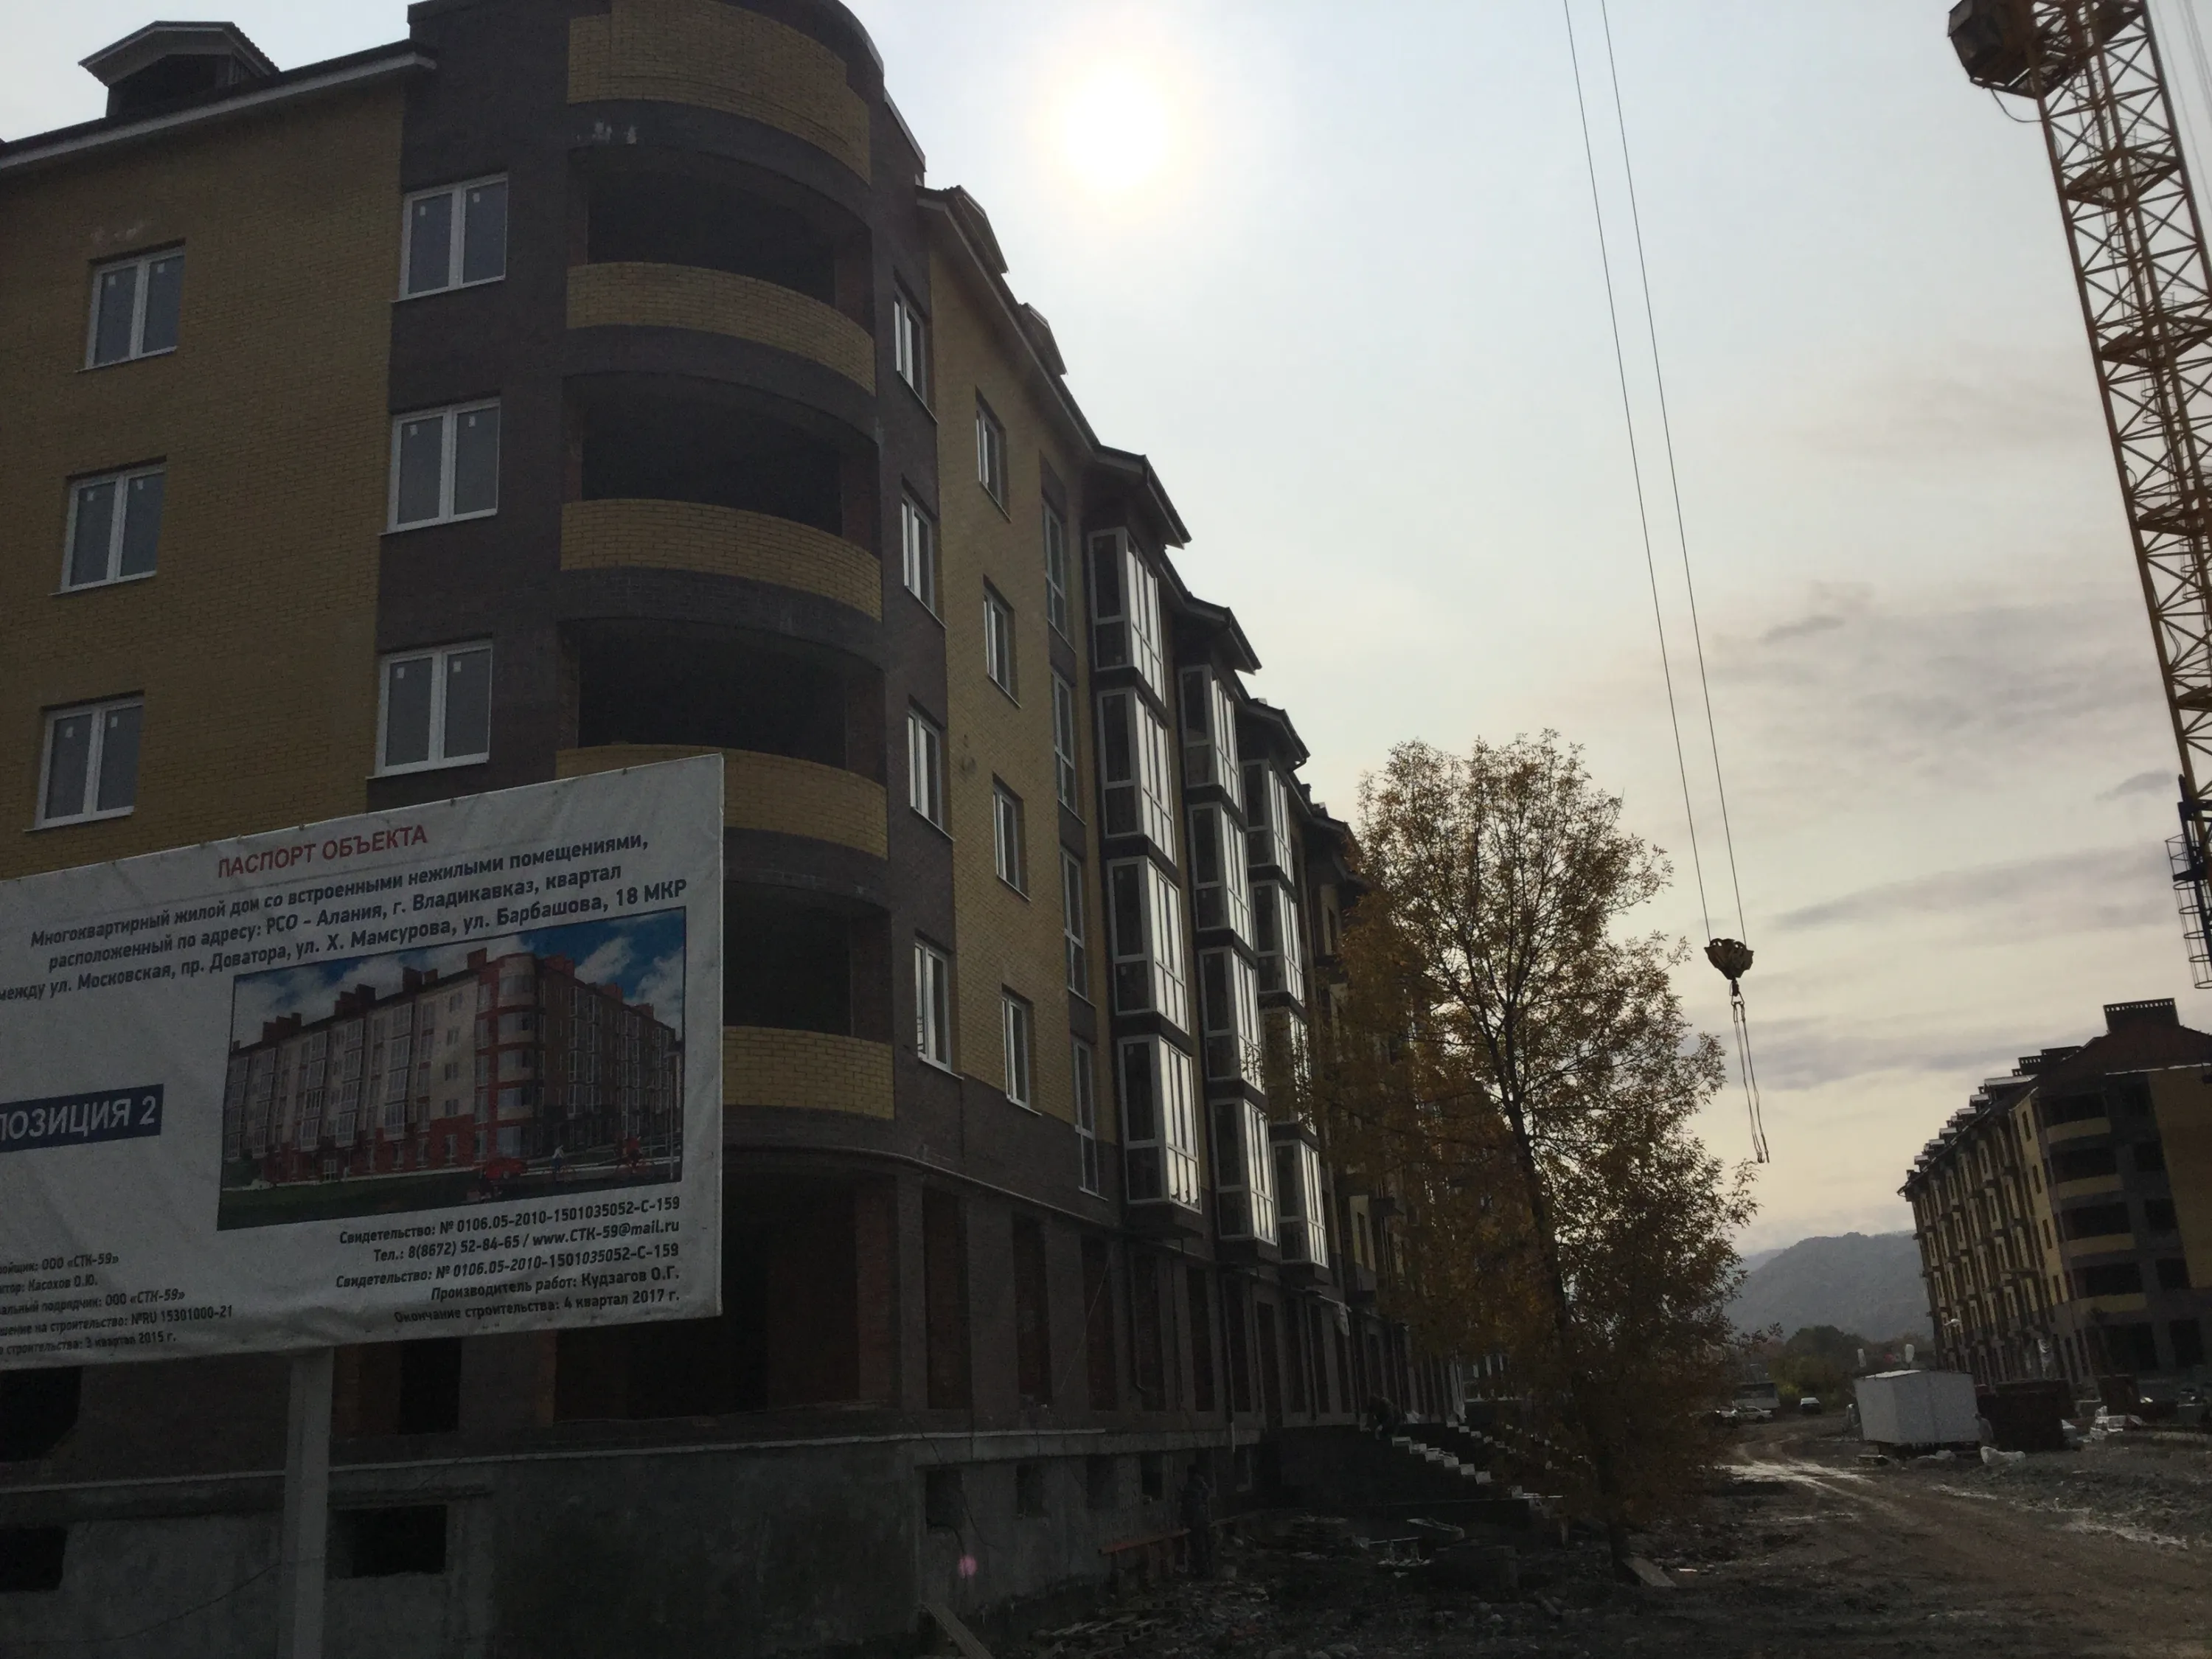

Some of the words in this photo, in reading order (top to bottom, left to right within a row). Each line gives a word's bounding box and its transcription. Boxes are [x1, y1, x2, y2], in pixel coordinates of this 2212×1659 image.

[218, 844, 316, 878] ПАСПОРТ
[322, 824, 427, 860] ОБЪЕКТА
[30, 909, 170, 947] Многоквартирный
[174, 900, 225, 923] жилой
[230, 897, 260, 917] дом
[264, 894, 282, 908] со
[288, 874, 403, 906] встроенными
[408, 858, 503, 884] нежилыми
[509, 836, 649, 870] помещениями,
[49, 935, 173, 973] расположенный
[177, 935, 196, 950] по
[201, 925, 261, 948] адресу:
[266, 914, 297, 934] РСО
[317, 902, 387, 926] Алания,
[392, 901, 406, 915] г.
[413, 879, 539, 911] Владикавказ,
[546, 866, 621, 891] квартал
[50, 981, 72, 998] ул.
[77, 965, 175, 990] Московская,
[181, 961, 204, 980] пр.
[209, 945, 291, 973] Доватора,
[296, 942, 319, 959] ул.
[351, 920, 457, 947] Мамсурова,
[464, 917, 490, 935] ул.
[497, 897, 608, 925] Барбашова,
[616, 886, 638, 907] 18
[644, 878, 686, 901] МКР
[139, 1096, 156, 1125] 2
[340, 1227, 435, 1244] Свидетельство:
[439, 1221, 453, 1234] №
[374, 1248, 404, 1262] Тел.:
[408, 1242, 456, 1261] 8(8672)
[461, 1237, 519, 1253] 52-84-65
[523, 1234, 529, 1248] /
[336, 1271, 432, 1288] Свидетельство:
[436, 1266, 450, 1279] №
[431, 1280, 532, 1302] Производитель
[536, 1276, 577, 1293] работ:
[582, 1271, 647, 1288] Кудзагов
[651, 1266, 679, 1280] О.Г.
[35, 1324, 47, 1333] на
[50, 1318, 128, 1335] строительство:
[161, 1305, 232, 1322] 15301000-21
[41, 1298, 102, 1312] подрядчик:
[394, 1310, 460, 1324] Окончание
[465, 1301, 559, 1319] строительства:
[564, 1296, 571, 1308] 4
[576, 1295, 629, 1310] квартал
[633, 1289, 664, 1304] 2017
[668, 1291, 679, 1301] г.
[7, 1340, 83, 1356] строительства:
[95, 1337, 135, 1349] квартал
[139, 1331, 164, 1343] 2015
[167, 1332, 176, 1342] г.
